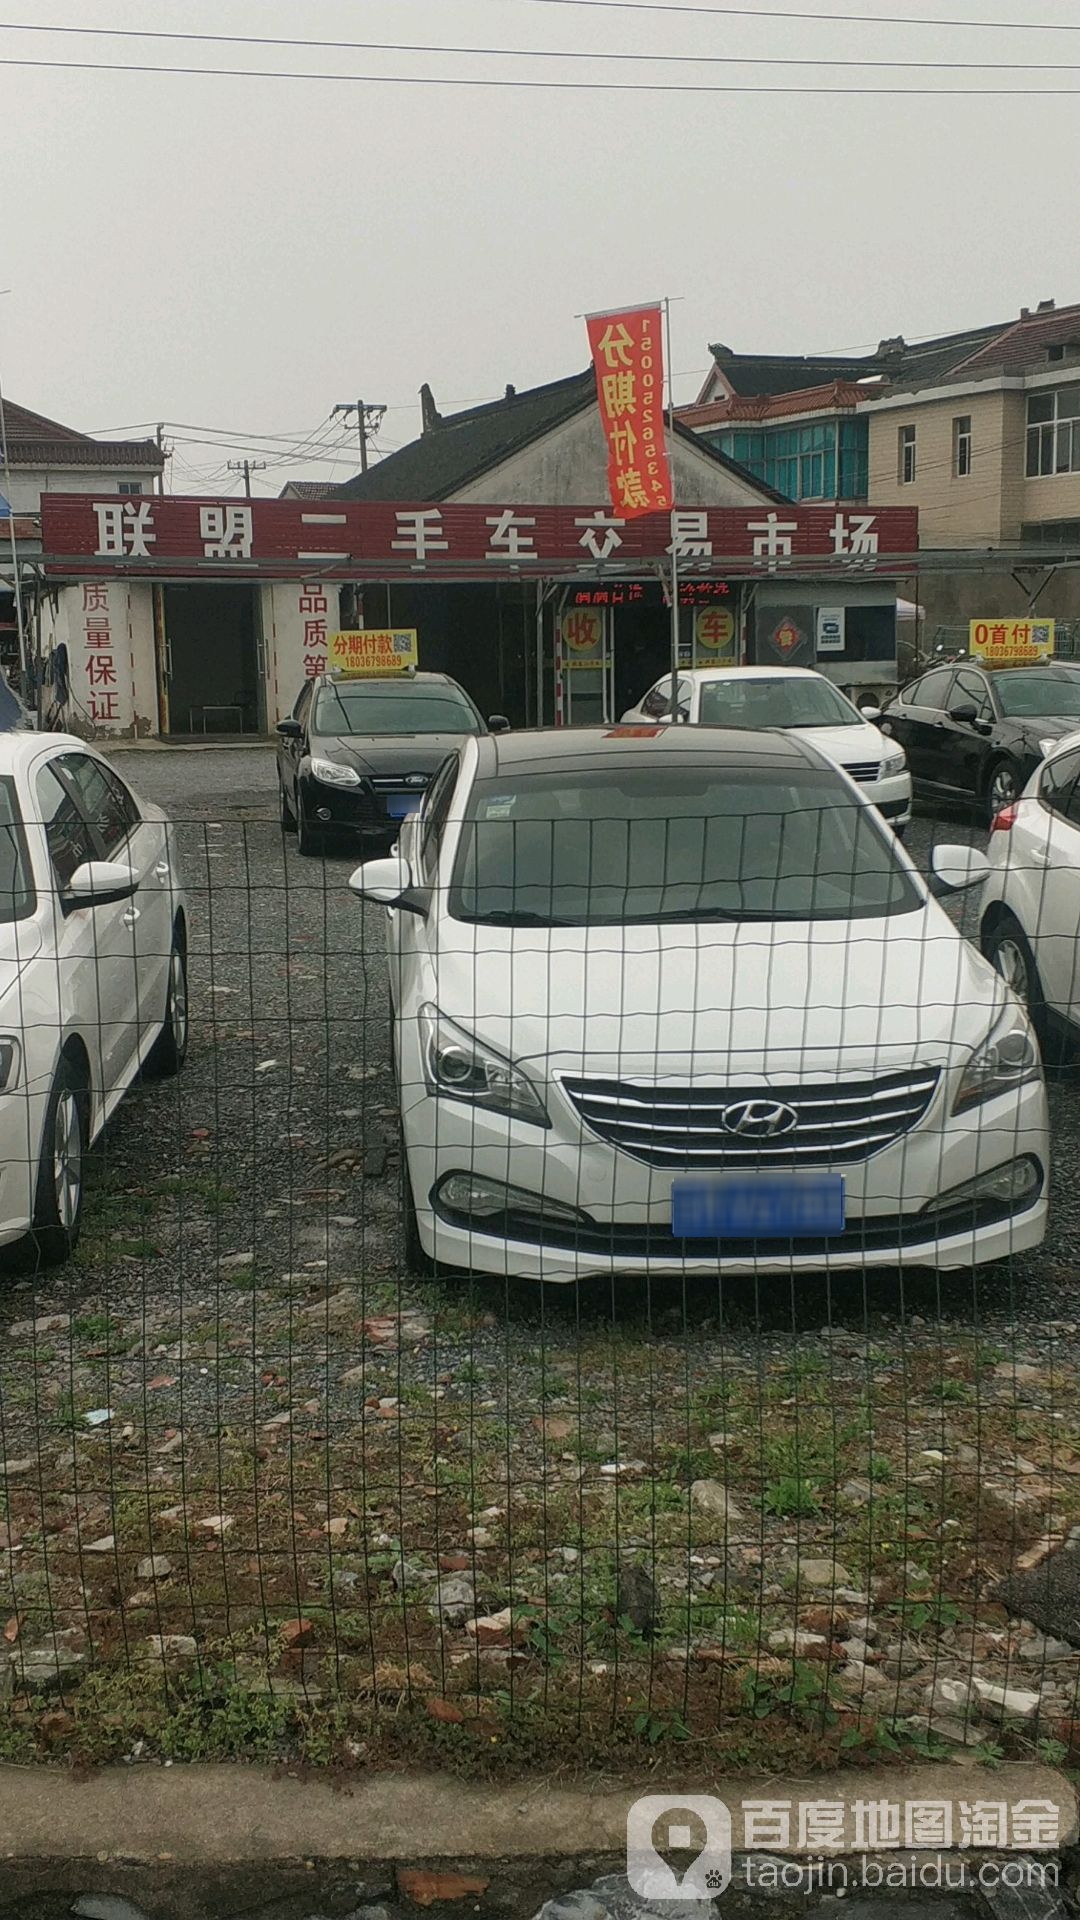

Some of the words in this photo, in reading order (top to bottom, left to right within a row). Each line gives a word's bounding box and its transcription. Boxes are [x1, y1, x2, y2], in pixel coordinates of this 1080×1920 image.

[92, 501, 880, 573] 联盟二手车交易市场
[567, 612, 598, 646] 收
[701, 611, 729, 644] 车
[975, 623, 1032, 645] 0首付
[82, 582, 121, 721] 质量保证
[333, 634, 393, 655] 分期付款
[345, 655, 402, 668] 18036798689
